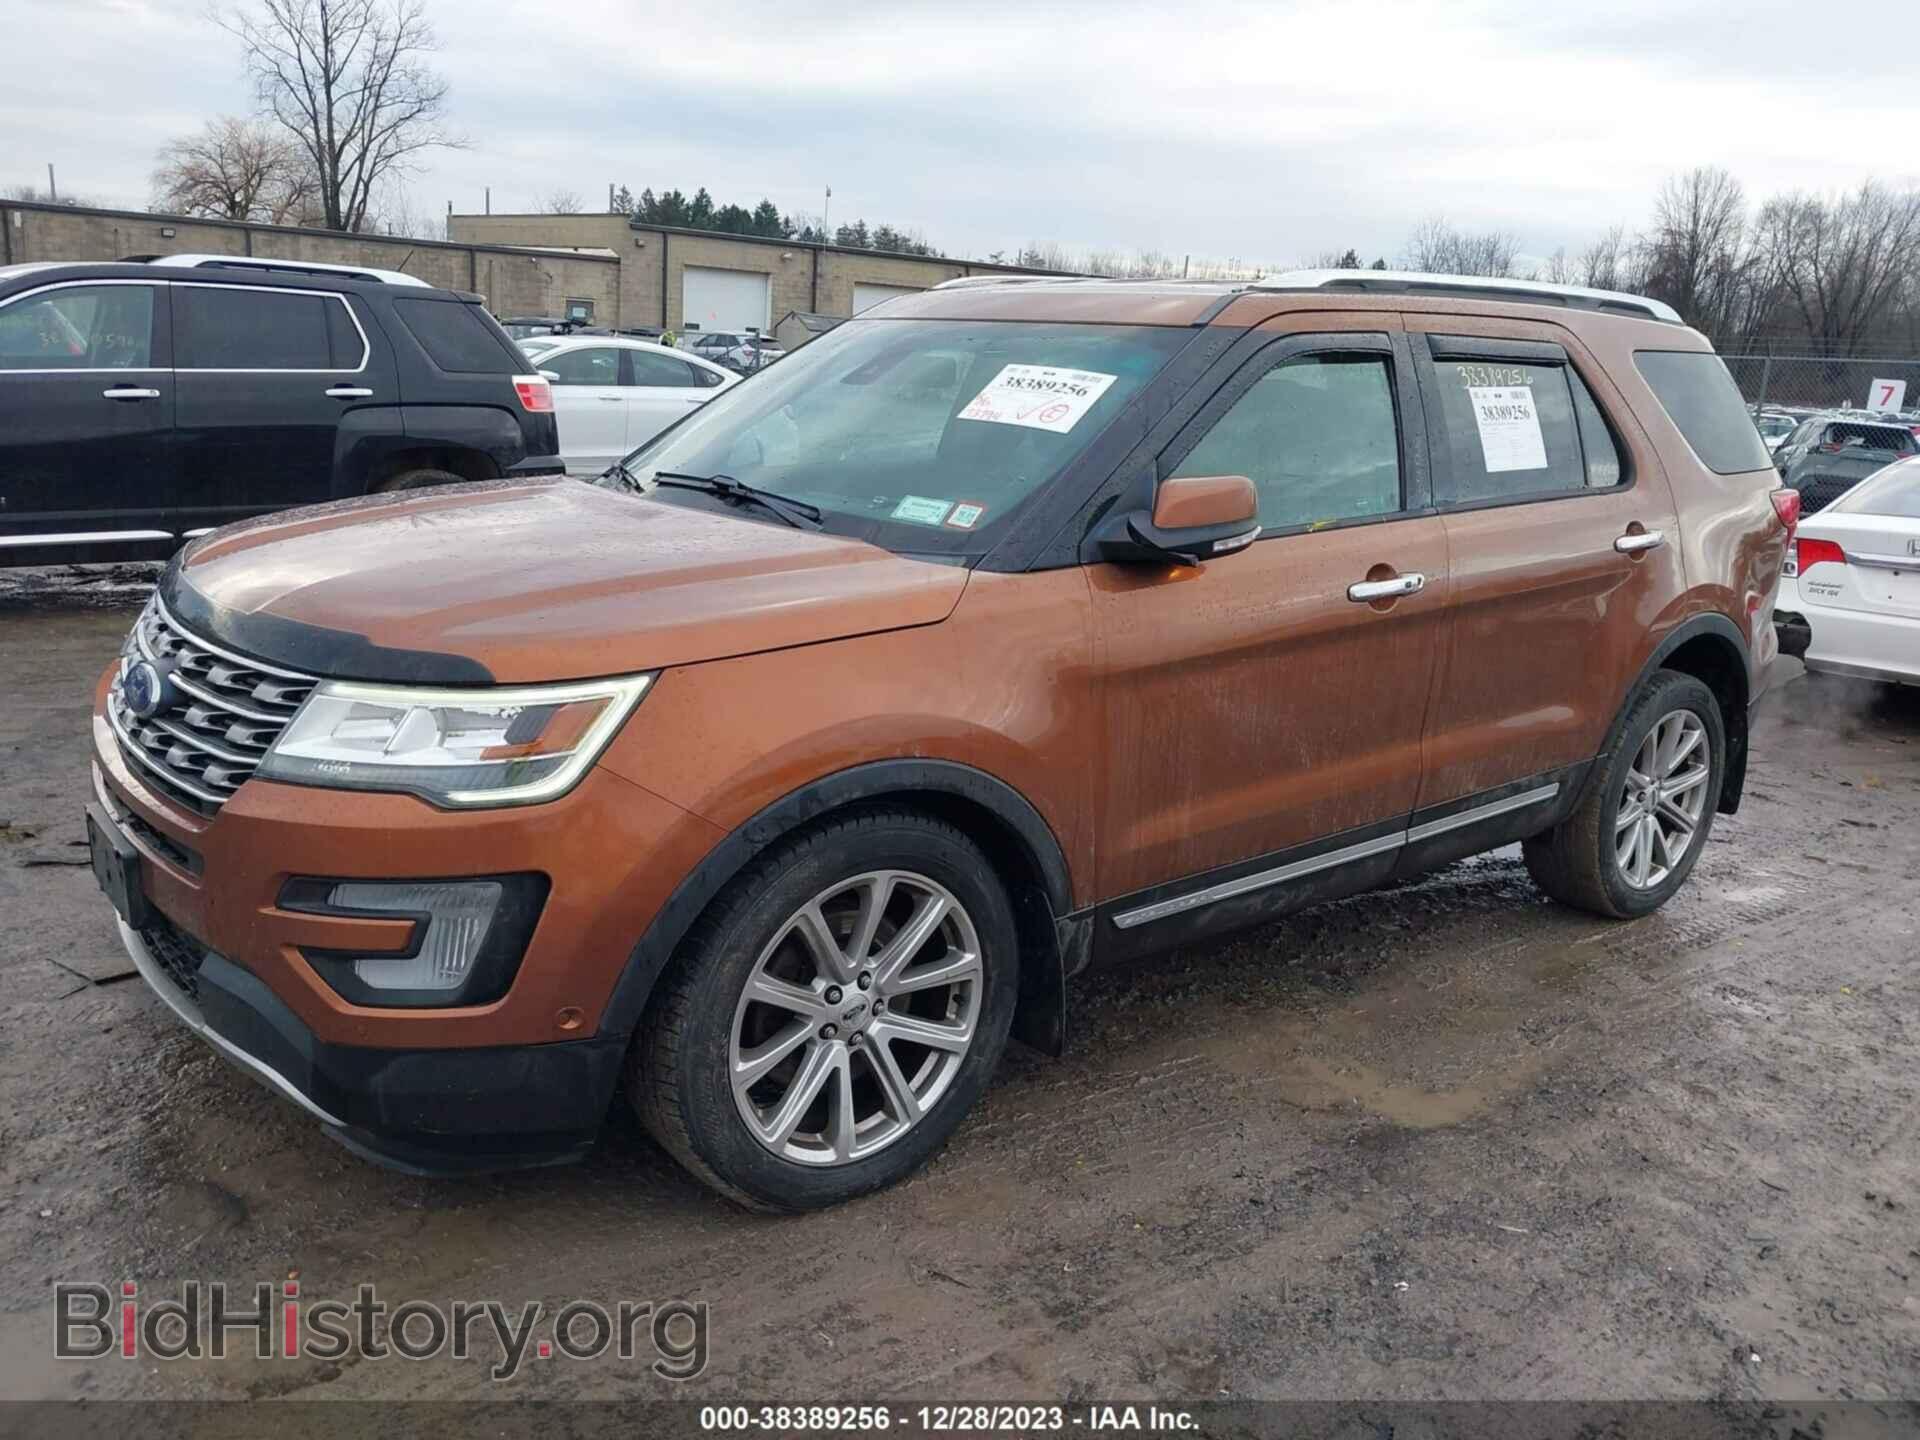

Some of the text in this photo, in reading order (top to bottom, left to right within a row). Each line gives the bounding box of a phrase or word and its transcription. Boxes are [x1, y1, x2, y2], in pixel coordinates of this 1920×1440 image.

[1000, 376, 1088, 398] 38389256
[1880, 385, 1895, 406] 7
[1481, 405, 1530, 421] 38389256
